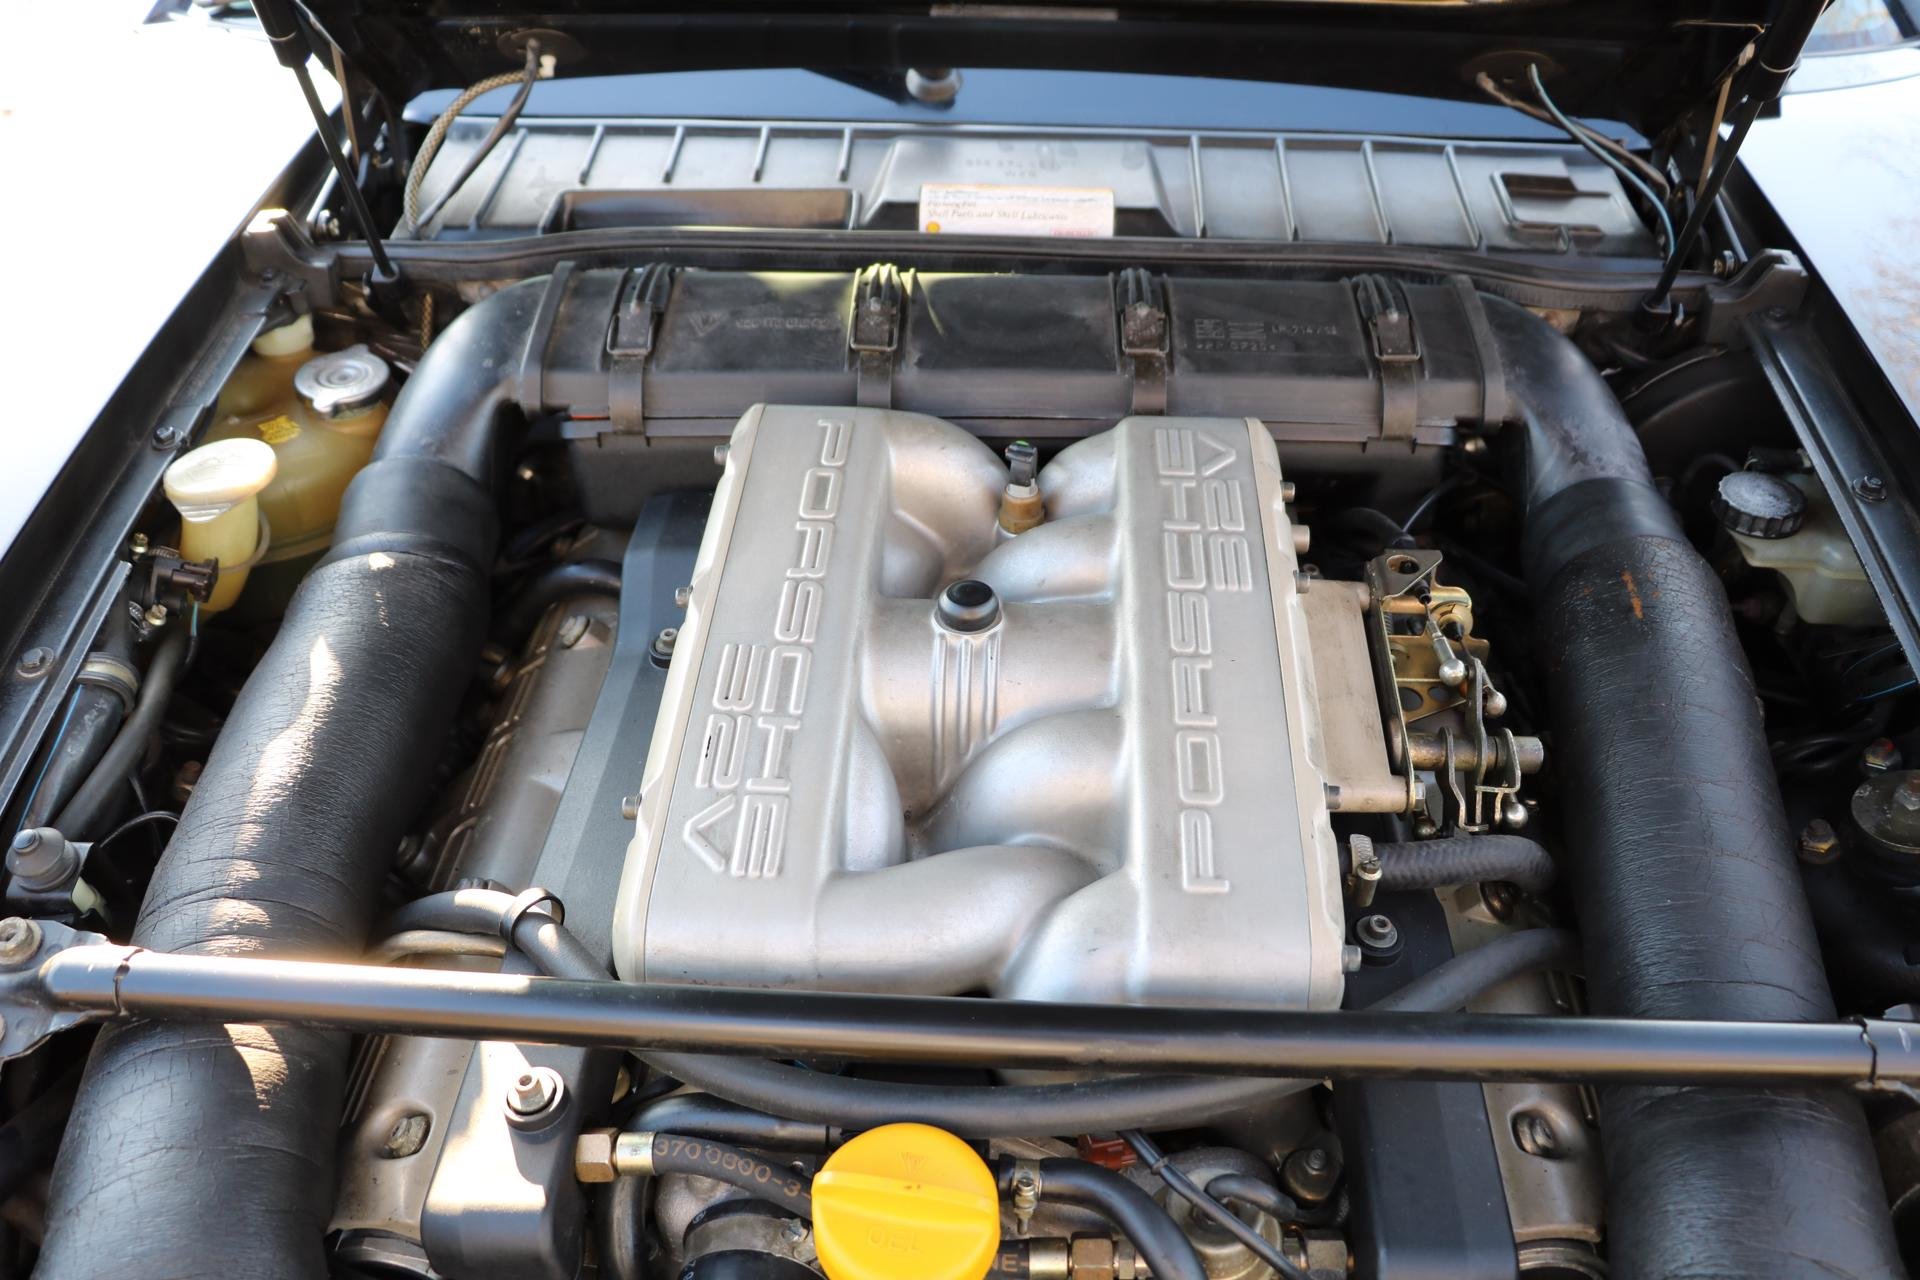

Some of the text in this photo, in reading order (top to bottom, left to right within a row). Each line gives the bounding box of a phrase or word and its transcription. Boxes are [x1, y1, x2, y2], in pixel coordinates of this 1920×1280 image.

[729, 418, 852, 878] PORSCHE
[1154, 428, 1231, 894] PORSCHE
[1198, 431, 1253, 592] 32V
[682, 642, 769, 873] 32V
